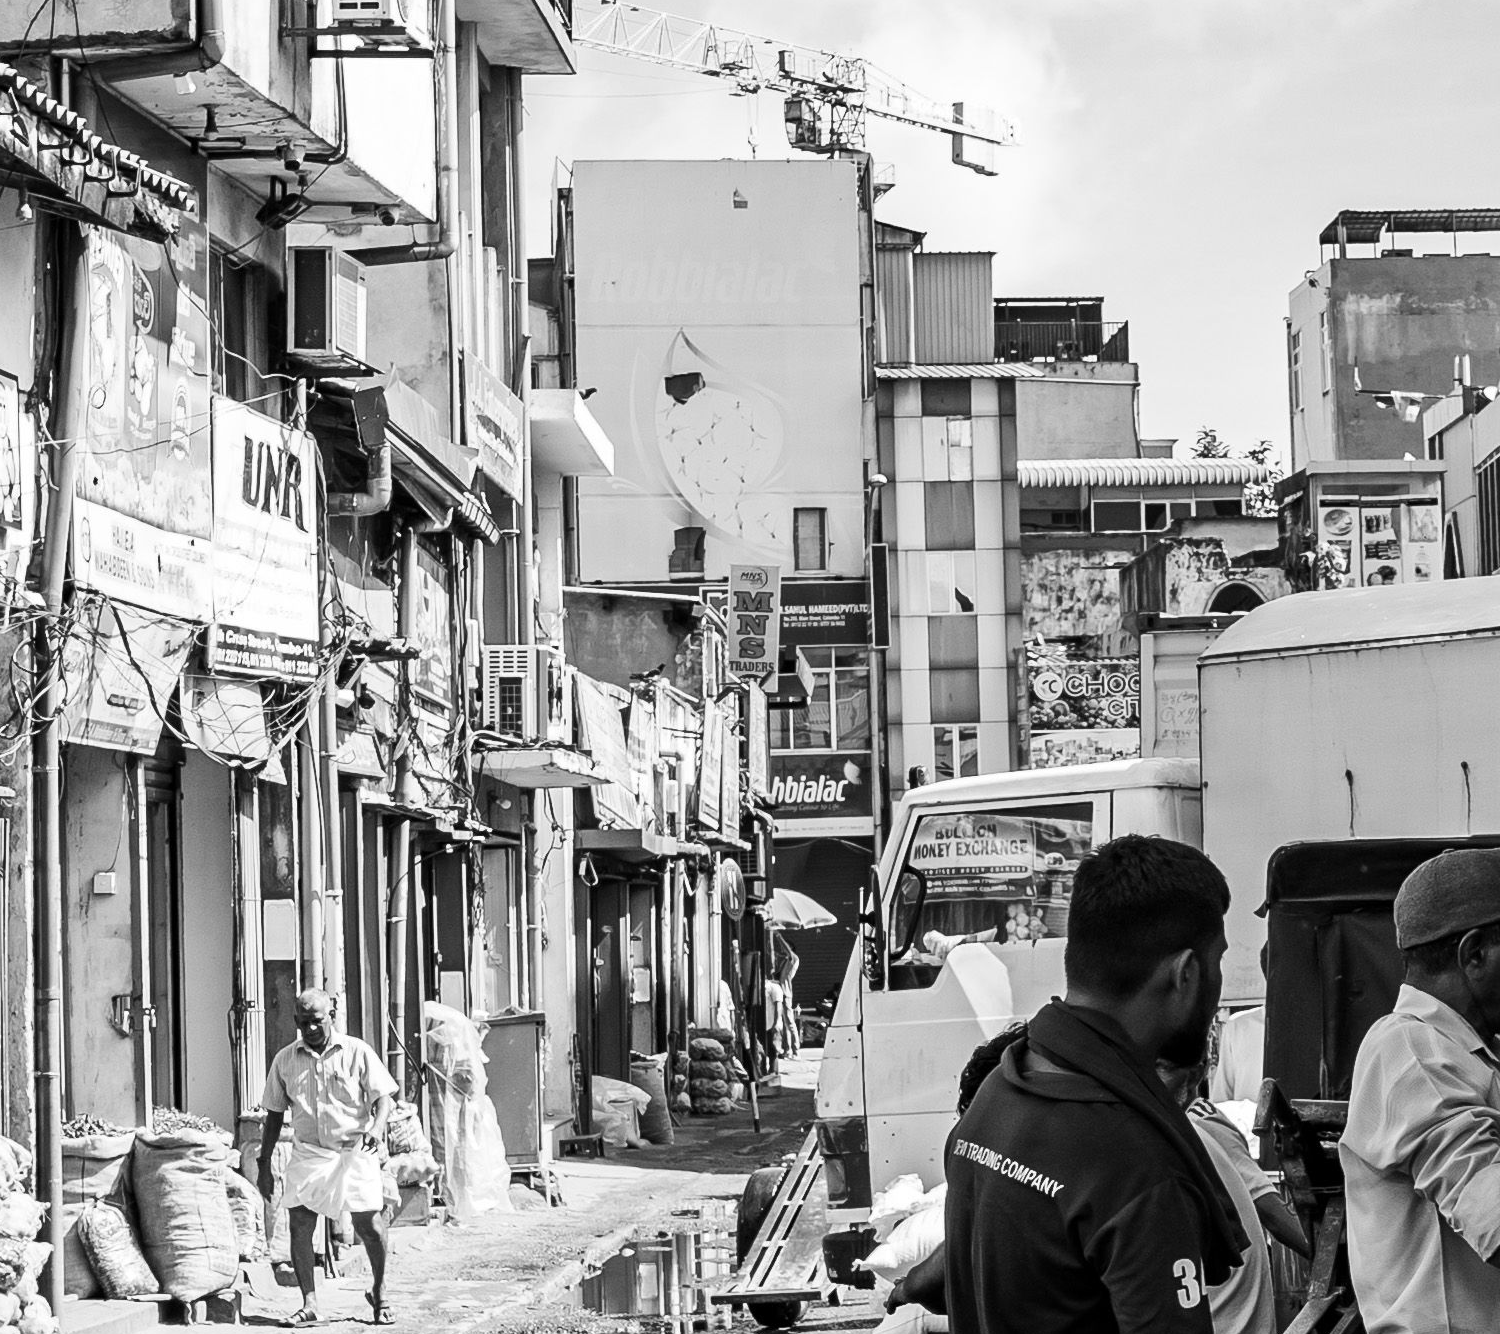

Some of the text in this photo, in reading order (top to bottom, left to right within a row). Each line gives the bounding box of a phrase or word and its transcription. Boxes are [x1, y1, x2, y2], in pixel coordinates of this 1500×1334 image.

[242, 434, 309, 534] UNR
[730, 661, 774, 672] TRADERS
[914, 839, 1028, 859] MONEY EXCHANGE
[935, 824, 997, 839] BULLION
[967, 1143, 1002, 1170] TRADING
[1001, 1158, 1064, 1197] COMPANY
[1173, 1258, 1208, 1309] 3
